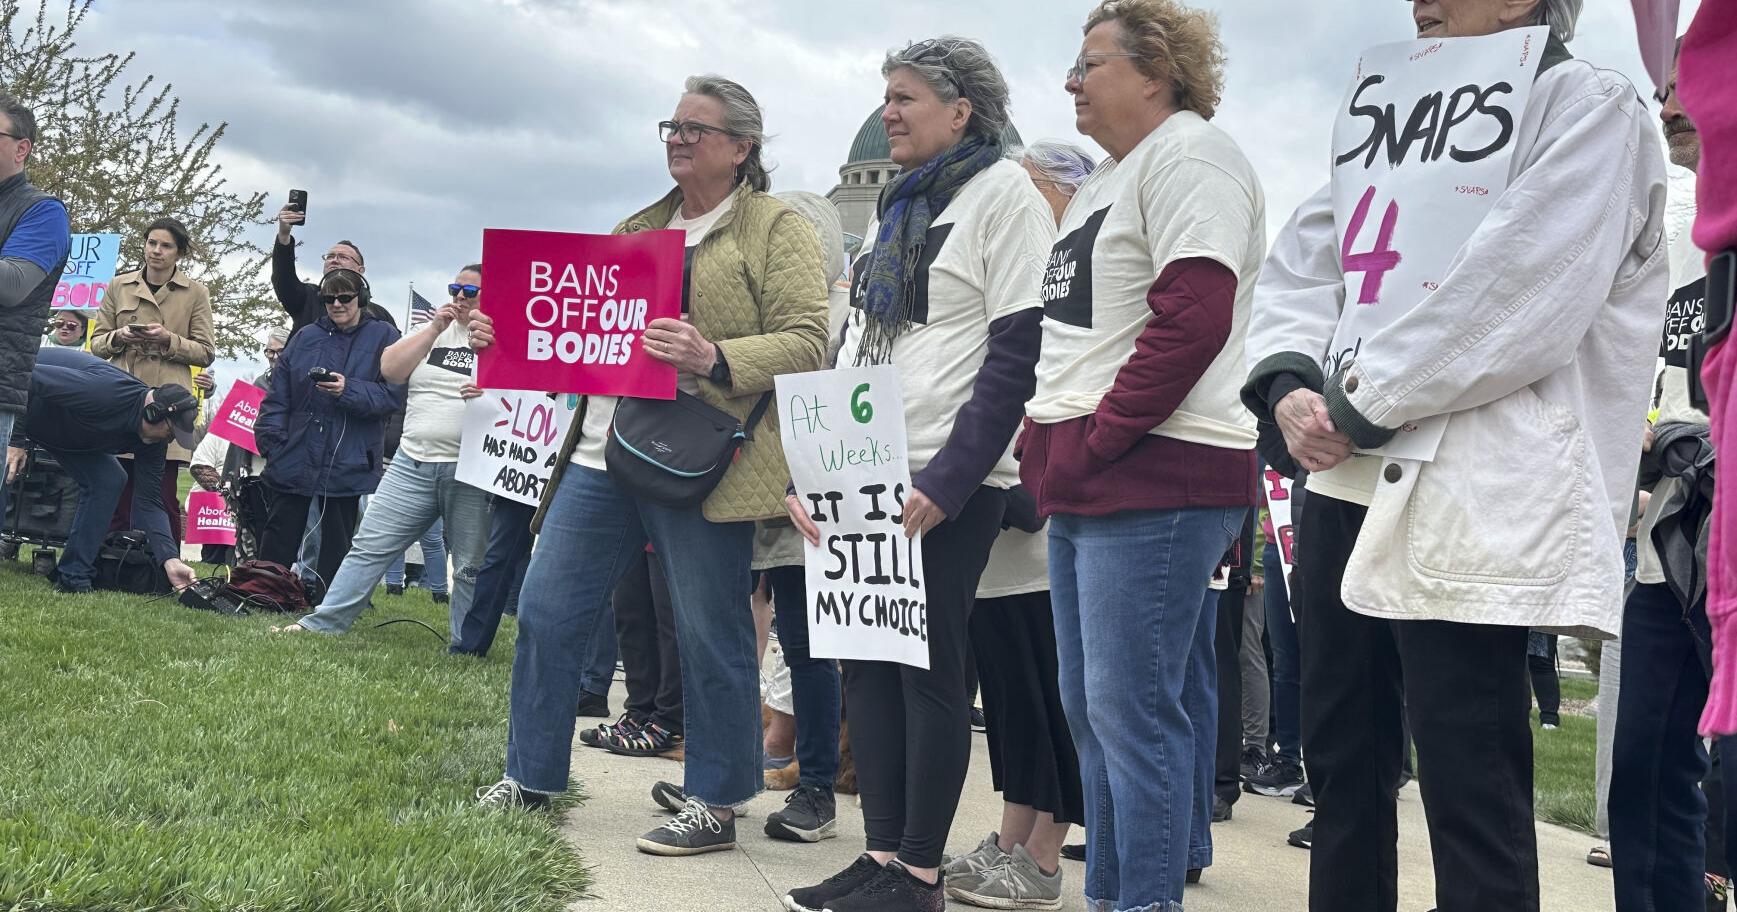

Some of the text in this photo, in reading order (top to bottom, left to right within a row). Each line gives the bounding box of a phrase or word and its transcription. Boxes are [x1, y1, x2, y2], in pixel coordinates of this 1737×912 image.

[1335, 74, 1514, 171] SNAPS
[1341, 184, 1402, 305] 4
[530, 261, 621, 297] BANS
[1041, 279, 1071, 301] ODIES
[527, 329, 636, 366] BODIES
[234, 400, 259, 416] Abo
[790, 382, 874, 441] At 6
[482, 433, 508, 458] HAS
[508, 441, 538, 464] HAD
[807, 482, 905, 525] IT IS
[824, 532, 920, 589] STILL
[815, 590, 927, 642] MY CHOICE
